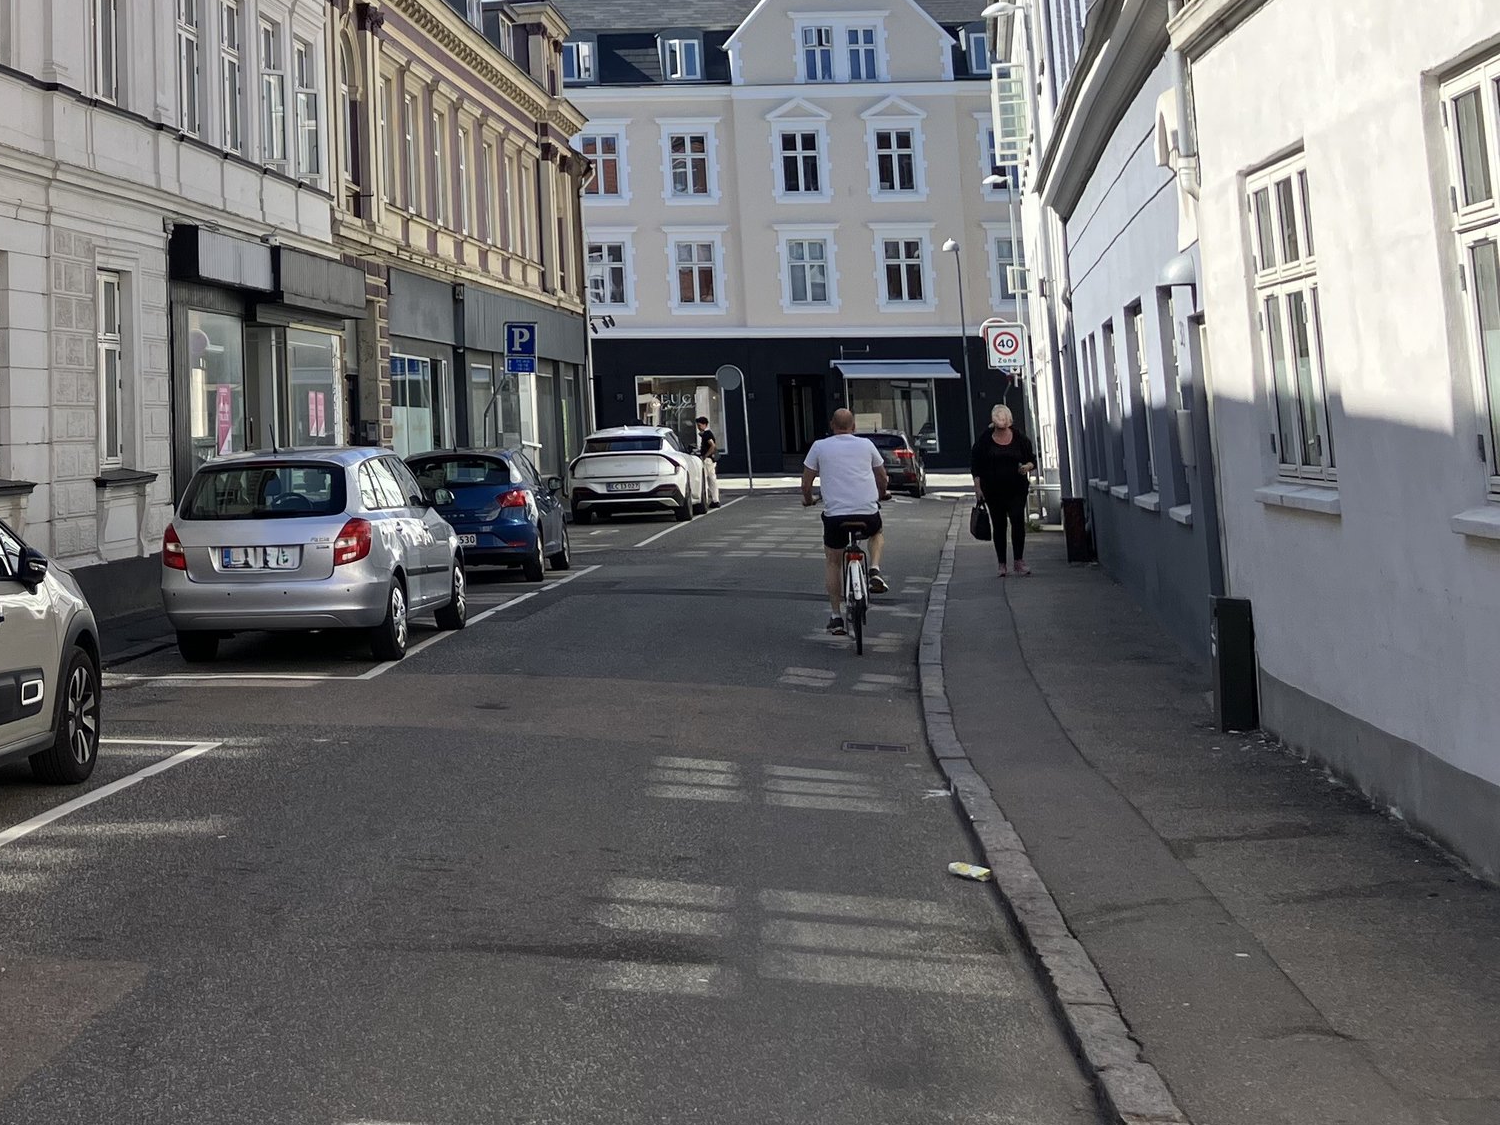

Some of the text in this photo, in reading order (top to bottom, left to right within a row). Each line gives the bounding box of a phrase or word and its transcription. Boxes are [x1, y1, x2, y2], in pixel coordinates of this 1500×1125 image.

[511, 327, 530, 351] P
[998, 339, 1014, 348] 40
[459, 535, 475, 544] 530
